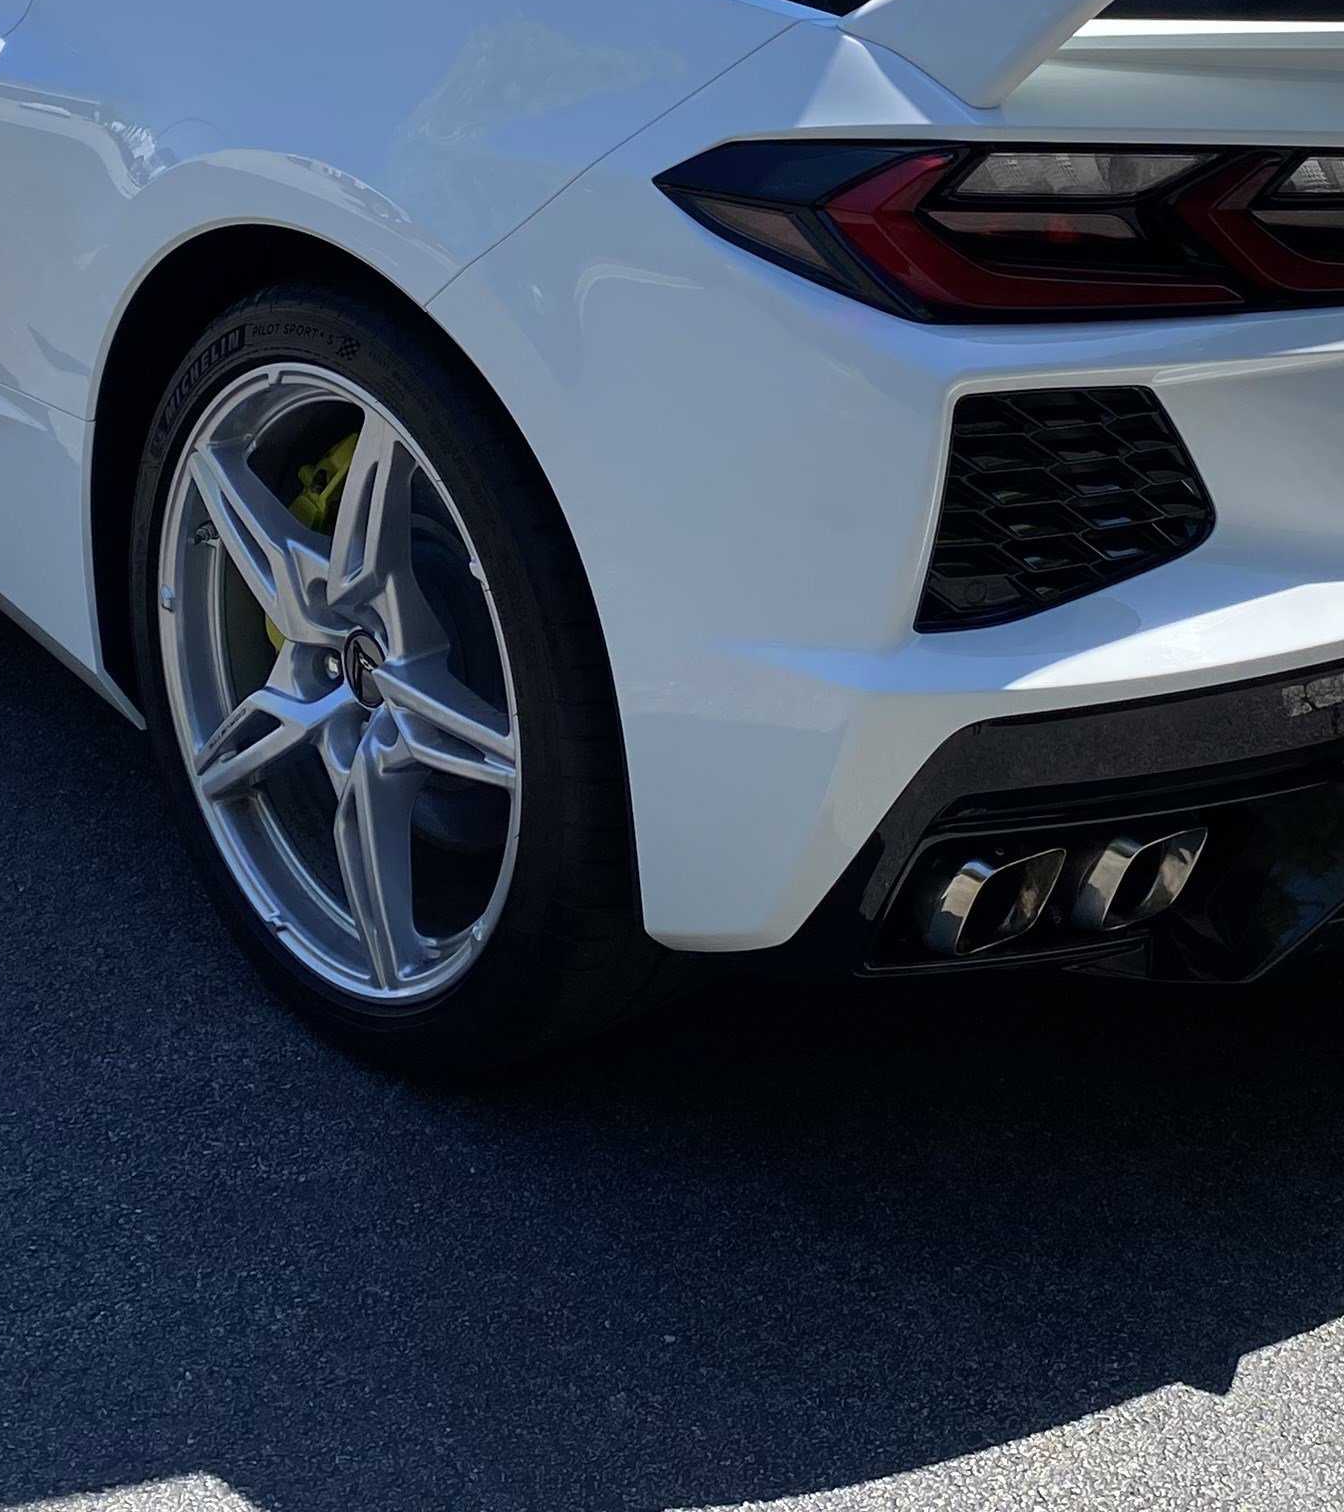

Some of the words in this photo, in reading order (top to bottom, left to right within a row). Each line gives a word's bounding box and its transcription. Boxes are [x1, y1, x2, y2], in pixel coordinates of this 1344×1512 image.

[163, 327, 242, 424] MICHELIN
[252, 323, 281, 337] PILOT
[283, 323, 318, 339] SPORT
[326, 334, 335, 345] S
